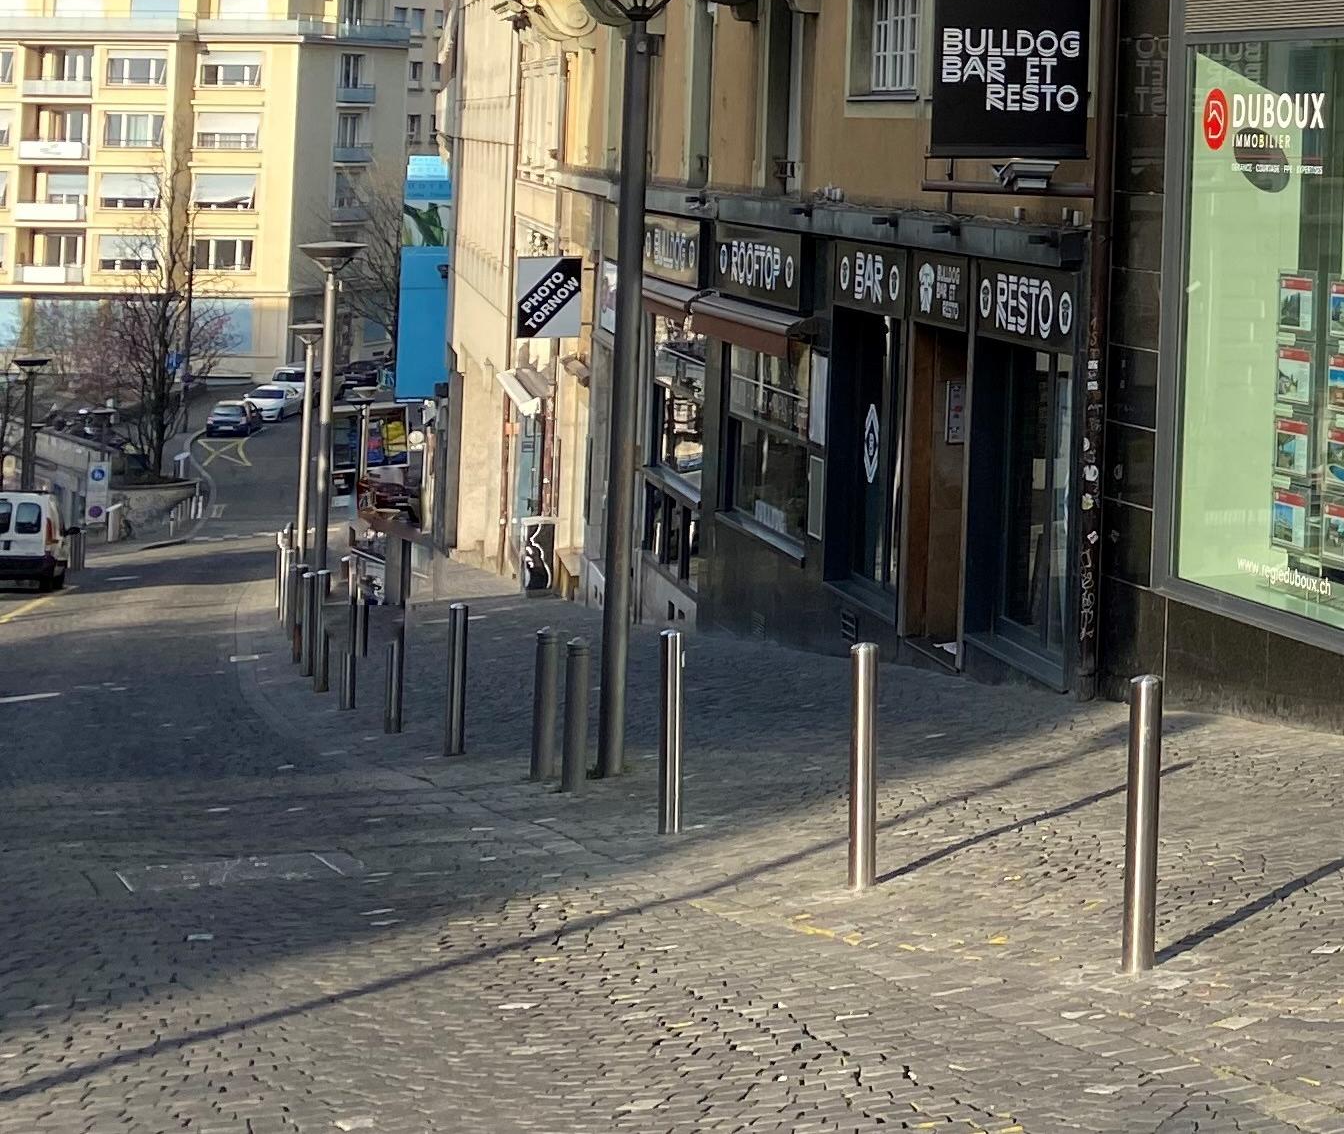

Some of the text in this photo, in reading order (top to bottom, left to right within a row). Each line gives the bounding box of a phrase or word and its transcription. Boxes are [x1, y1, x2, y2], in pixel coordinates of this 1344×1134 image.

[942, 27, 1081, 58] BULLDOG
[941, 56, 1058, 84] BAR ET
[985, 84, 1080, 112] RESTO
[1232, 92, 1326, 130] DUBOUX
[1231, 133, 1292, 149] IMMOBILIER
[730, 240, 781, 291] ROOFTOP
[853, 251, 883, 304] BAR
[936, 264, 961, 286] BULLDOG
[520, 271, 565, 314] PHOTO
[524, 276, 579, 330] TORNOW
[936, 281, 957, 300] BAR ET
[995, 273, 1053, 340] RESTO
[1236, 555, 1332, 596] www.regieduboux.ch
